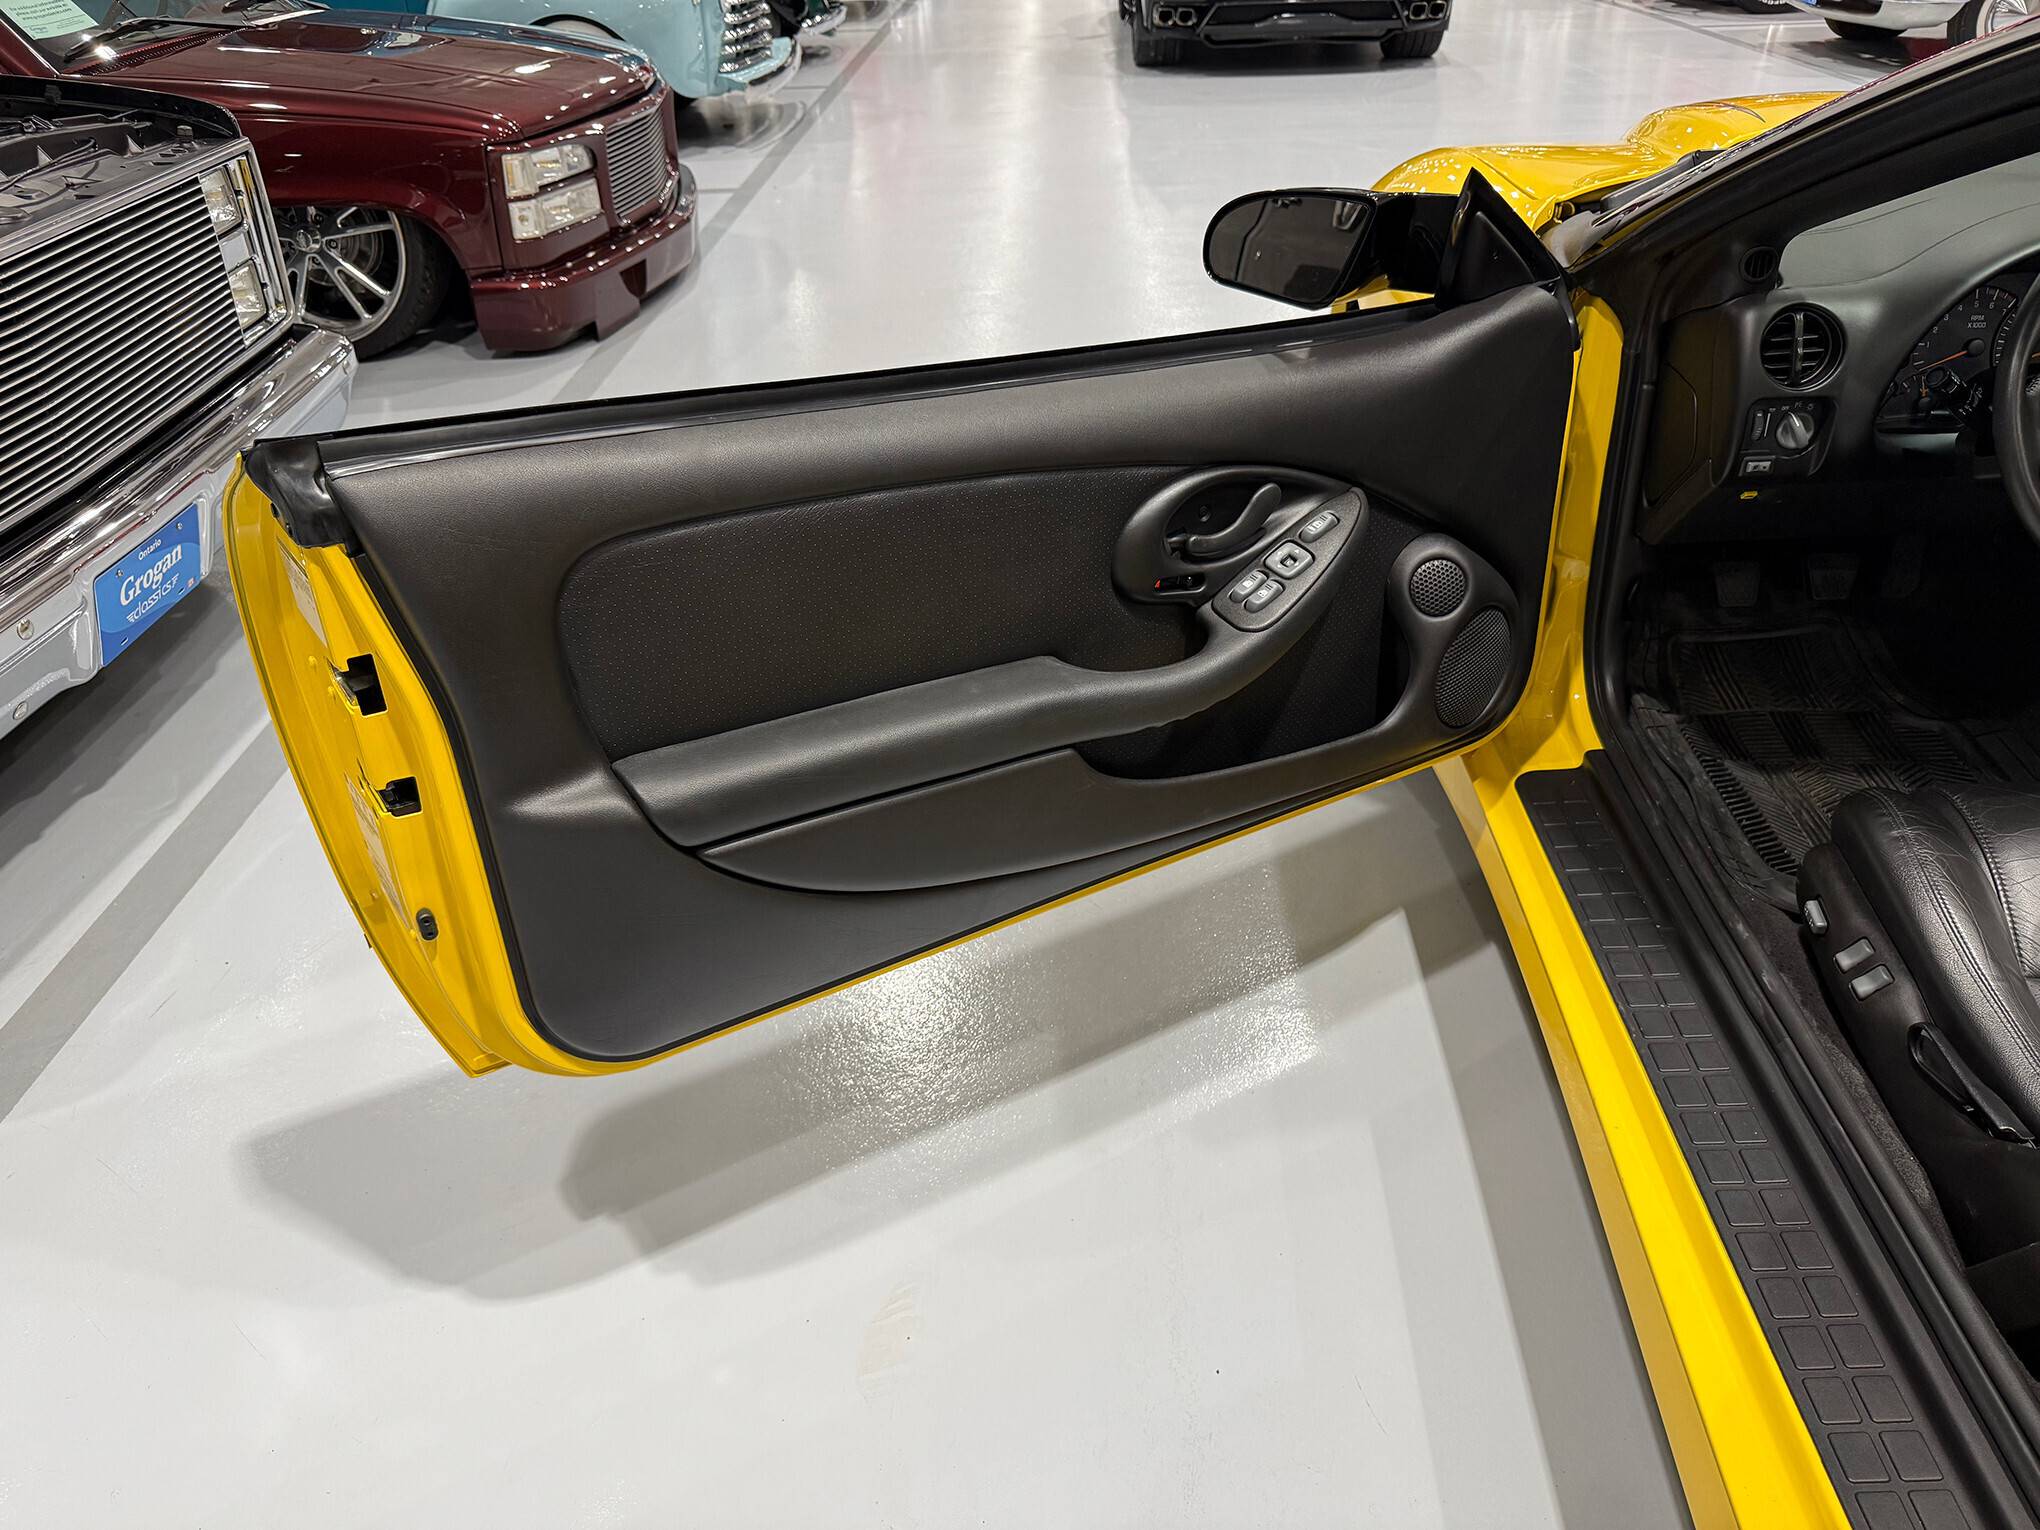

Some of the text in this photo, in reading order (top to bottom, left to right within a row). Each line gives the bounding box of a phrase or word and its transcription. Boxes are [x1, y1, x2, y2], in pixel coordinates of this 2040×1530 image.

[138, 539, 162, 560] Ontario
[120, 544, 182, 606] Grogan
[132, 578, 173, 620] classics
